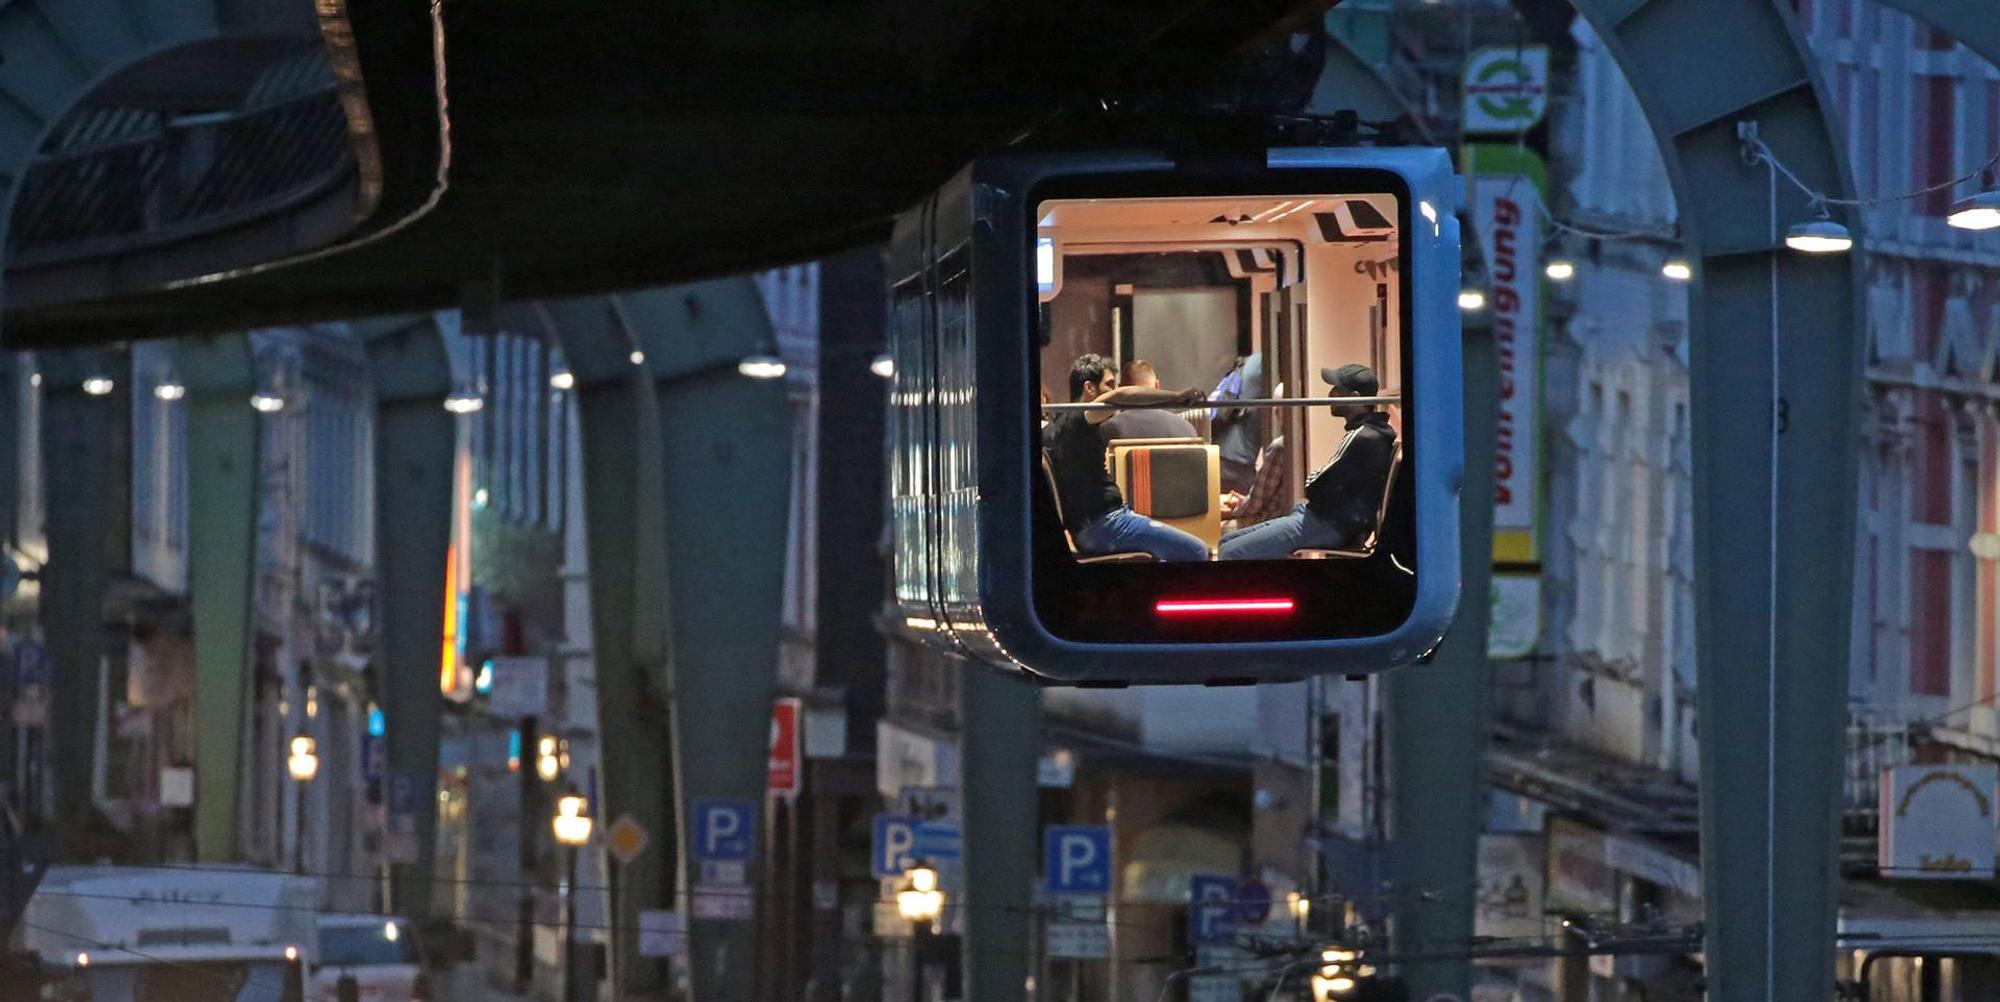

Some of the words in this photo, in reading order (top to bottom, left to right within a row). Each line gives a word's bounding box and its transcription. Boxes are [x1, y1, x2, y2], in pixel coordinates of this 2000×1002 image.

[706, 807, 740, 854] P
[884, 822, 914, 871] P
[1060, 833, 1097, 887] P
